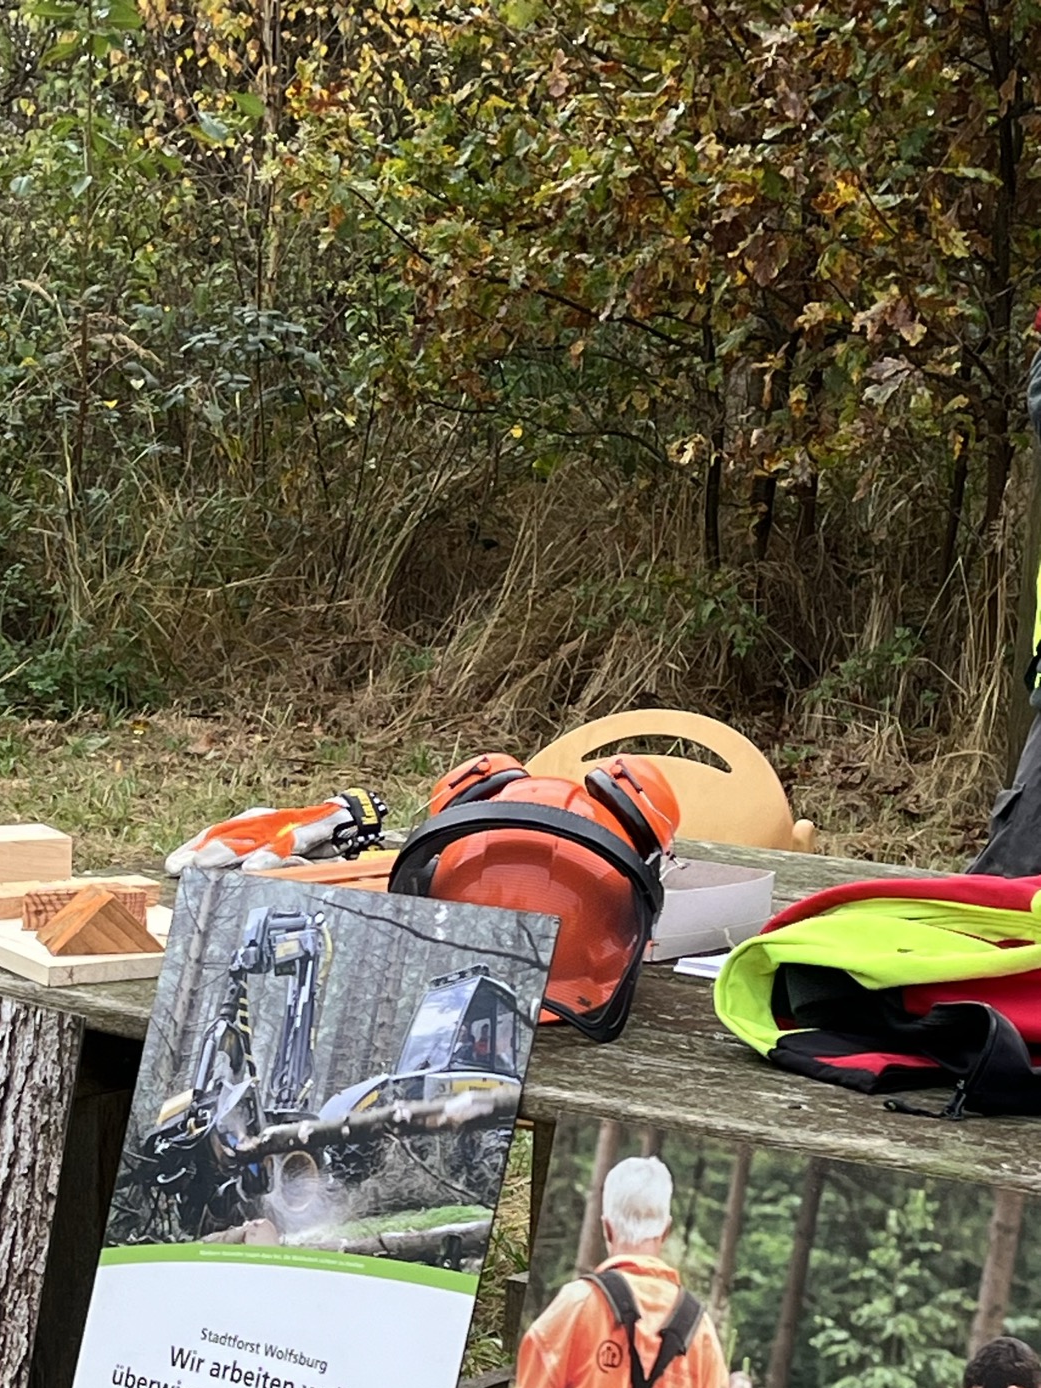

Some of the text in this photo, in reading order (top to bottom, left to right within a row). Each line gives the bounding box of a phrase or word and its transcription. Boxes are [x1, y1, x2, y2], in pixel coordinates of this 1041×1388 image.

[171, 1346, 205, 1373] Wir
[201, 1328, 327, 1374] Stadtforst Wolfsburg
